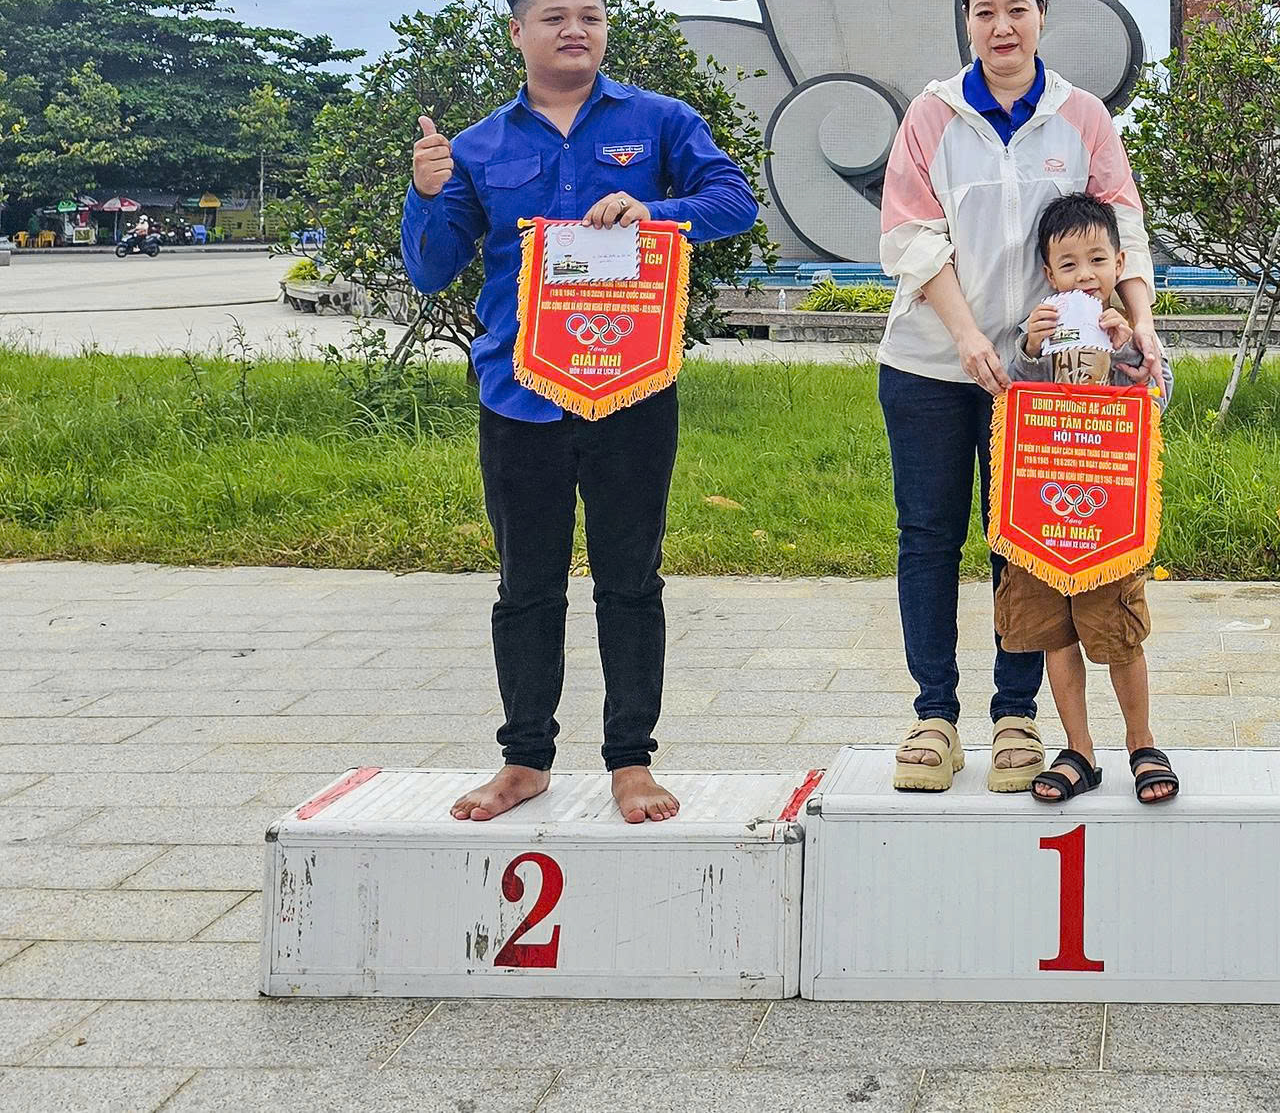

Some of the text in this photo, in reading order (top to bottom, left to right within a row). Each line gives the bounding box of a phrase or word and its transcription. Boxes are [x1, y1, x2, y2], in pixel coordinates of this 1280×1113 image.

[645, 250, 662, 264] ÍCH
[571, 351, 621, 366] GIẢI NHÌ
[1032, 398, 1053, 411] UBND
[1024, 413, 1134, 433] TRUNG TÂM CÔNG ÍCH
[1053, 430, 1102, 445] HỘI THAO
[1042, 522, 1102, 541] GIẢI NHẤT
[1039, 824, 1104, 972] 1
[494, 852, 564, 969] 2
